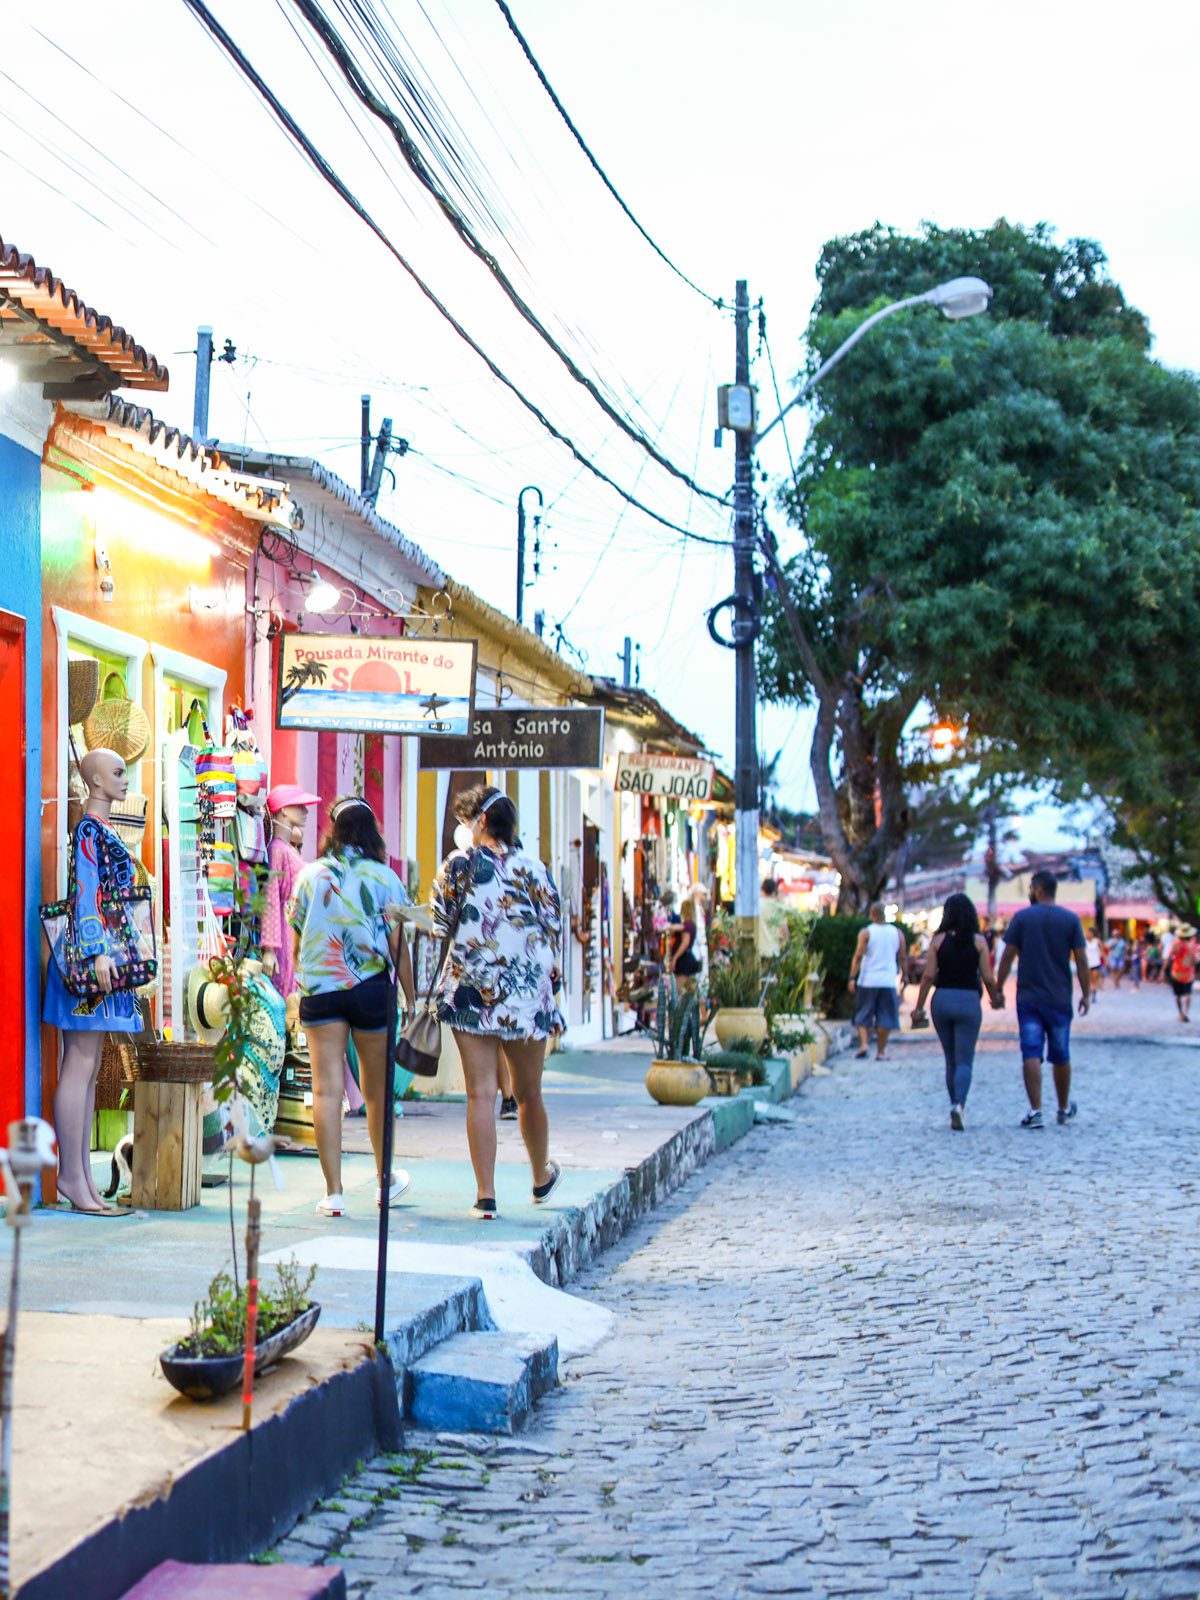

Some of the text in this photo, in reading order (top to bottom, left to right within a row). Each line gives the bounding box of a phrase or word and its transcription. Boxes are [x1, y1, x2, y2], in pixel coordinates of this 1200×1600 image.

[294, 646, 454, 670] Pousada Mirante do
[473, 717, 571, 735] sa Santo
[474, 739, 545, 758] Antônio
